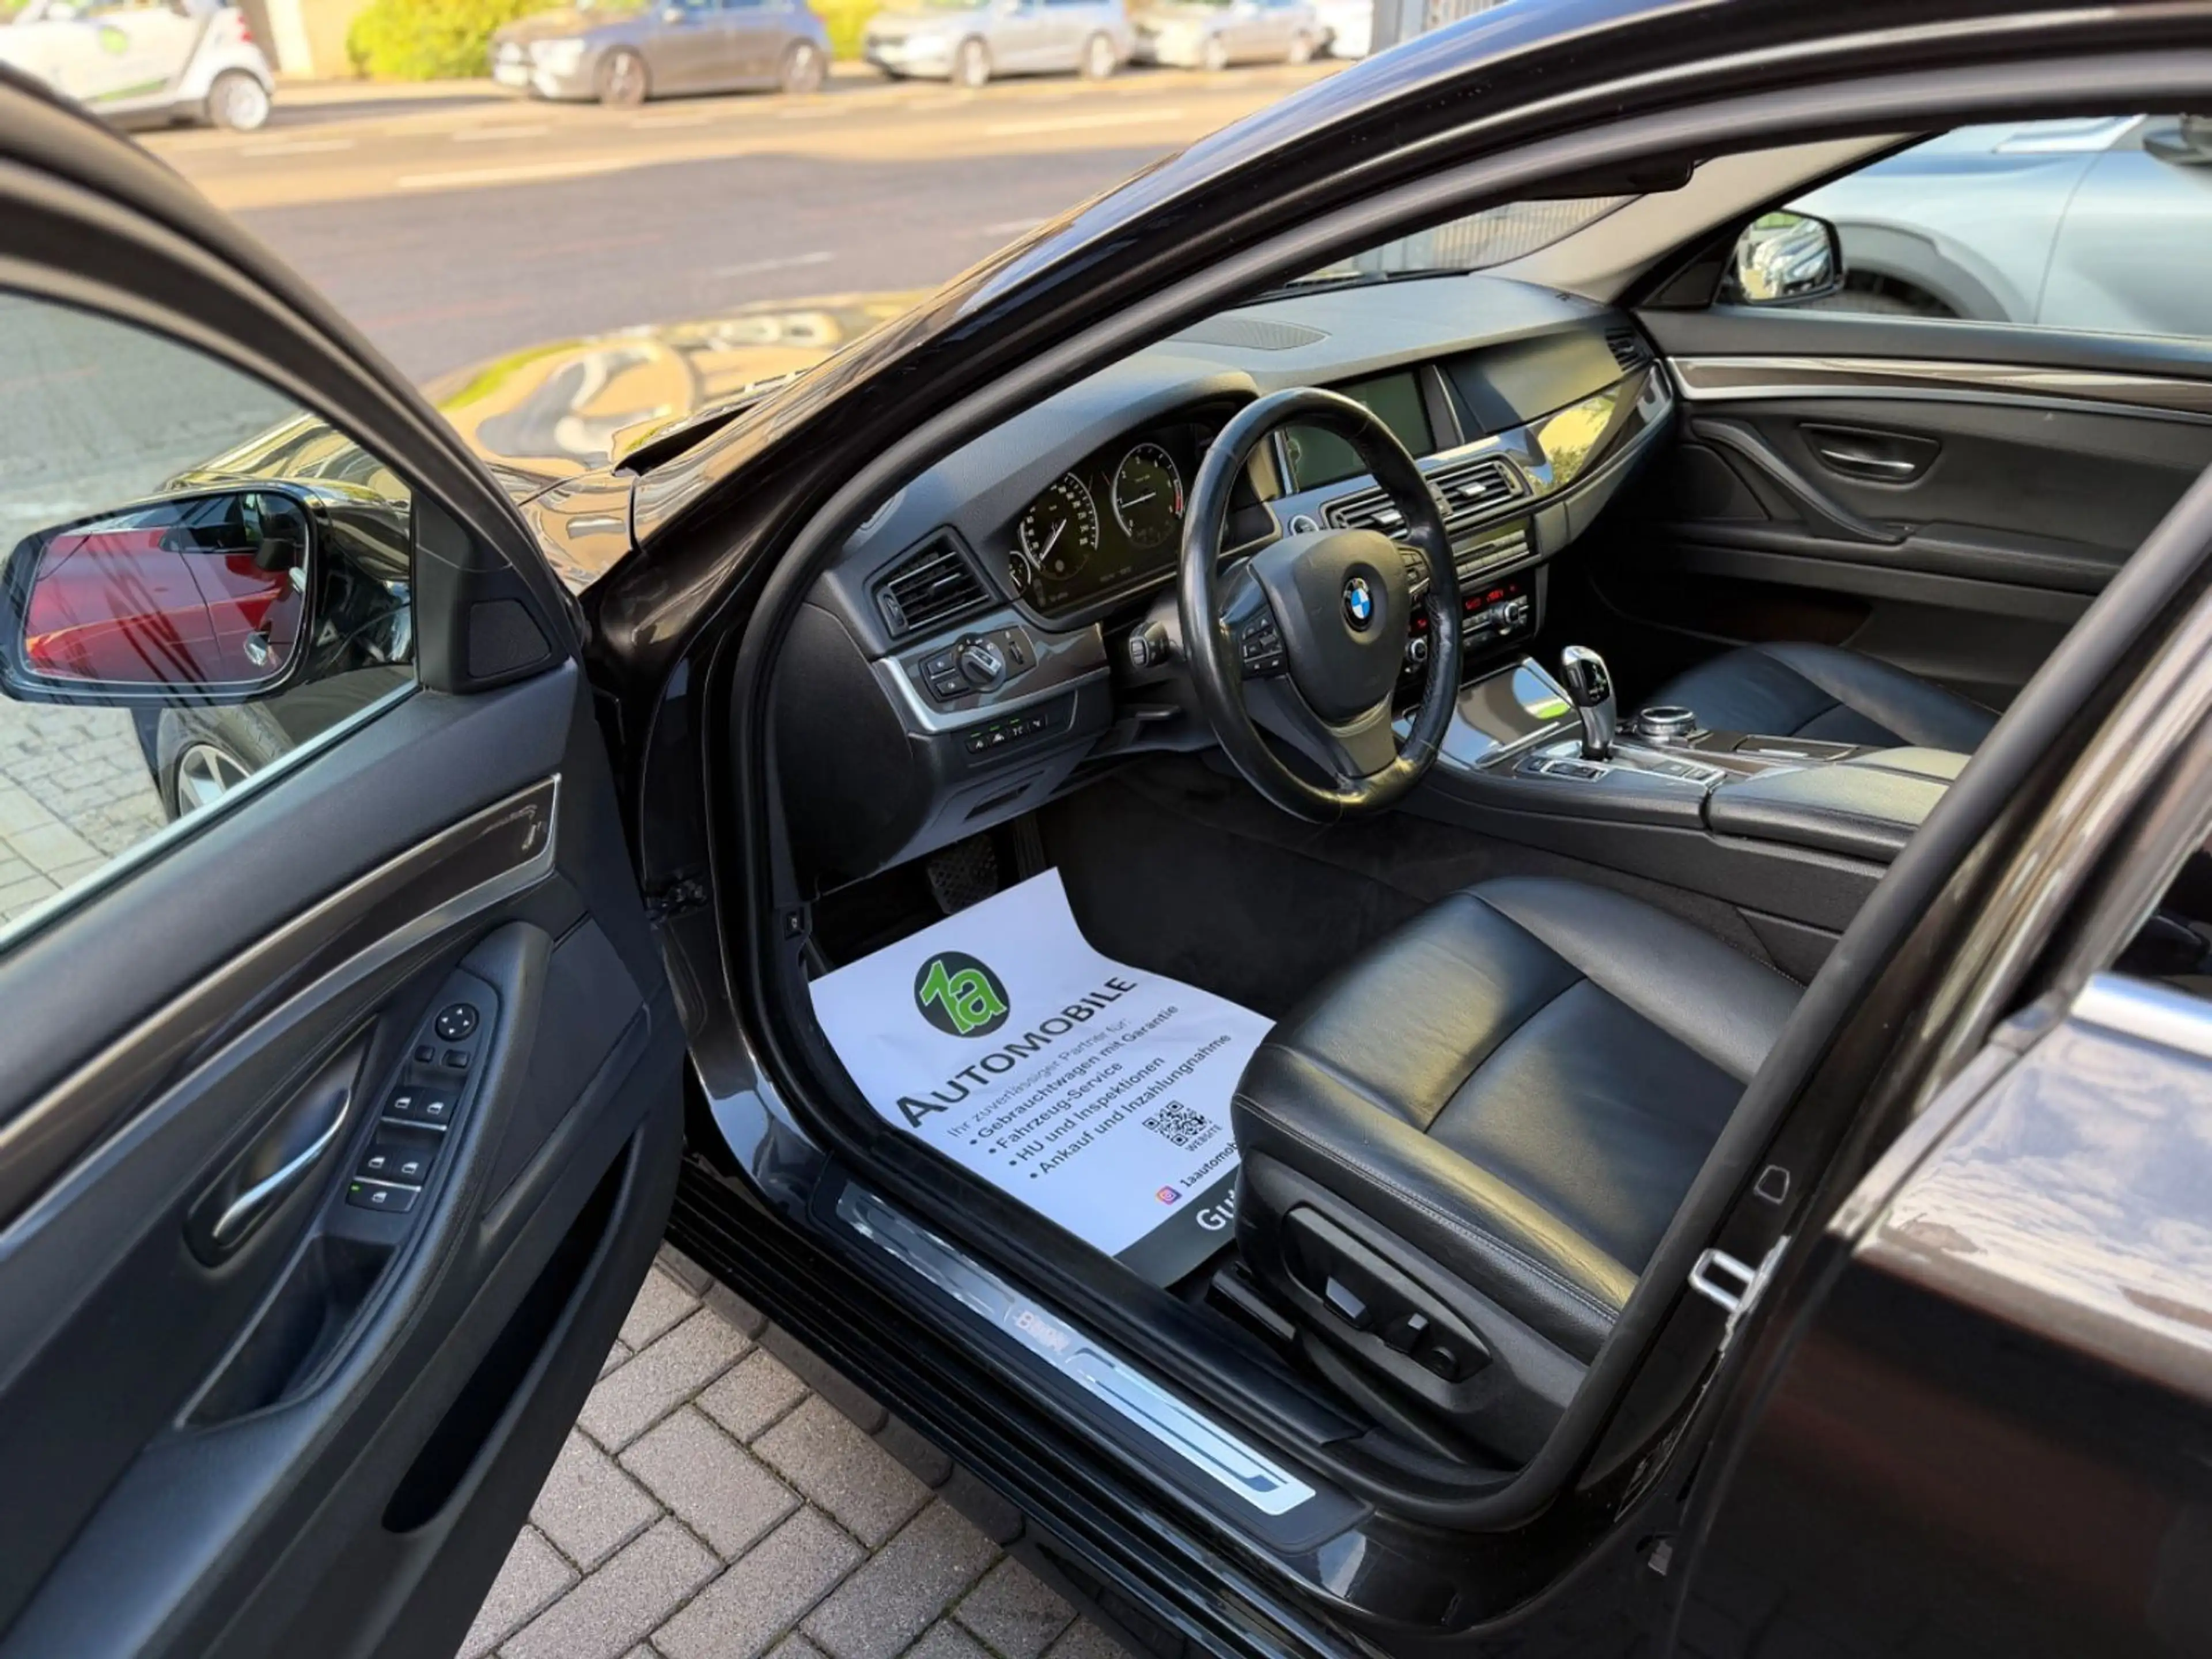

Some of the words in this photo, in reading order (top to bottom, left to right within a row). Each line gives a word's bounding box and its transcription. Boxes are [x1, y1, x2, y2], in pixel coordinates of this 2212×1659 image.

[920, 960, 1007, 1034] 1a
[896, 977, 1138, 1128] AUTOMOBILE
[978, 1055, 1101, 1138] Gebrauchtwagen
[1099, 1040, 1125, 1057] mit
[1122, 1005, 1179, 1043] Garantie
[1039, 1131, 1095, 1174] Ankauf
[1094, 1109, 1126, 1135] und
[1120, 1035, 1232, 1114] Inzahlungnahme
[947, 1120, 971, 1138] Ihr
[996, 1062, 1123, 1149] Fahrzeug-Service
[1016, 1140, 1044, 1161] HU
[1044, 1118, 1077, 1142] und
[1073, 1056, 1166, 1121] Inspektionen
